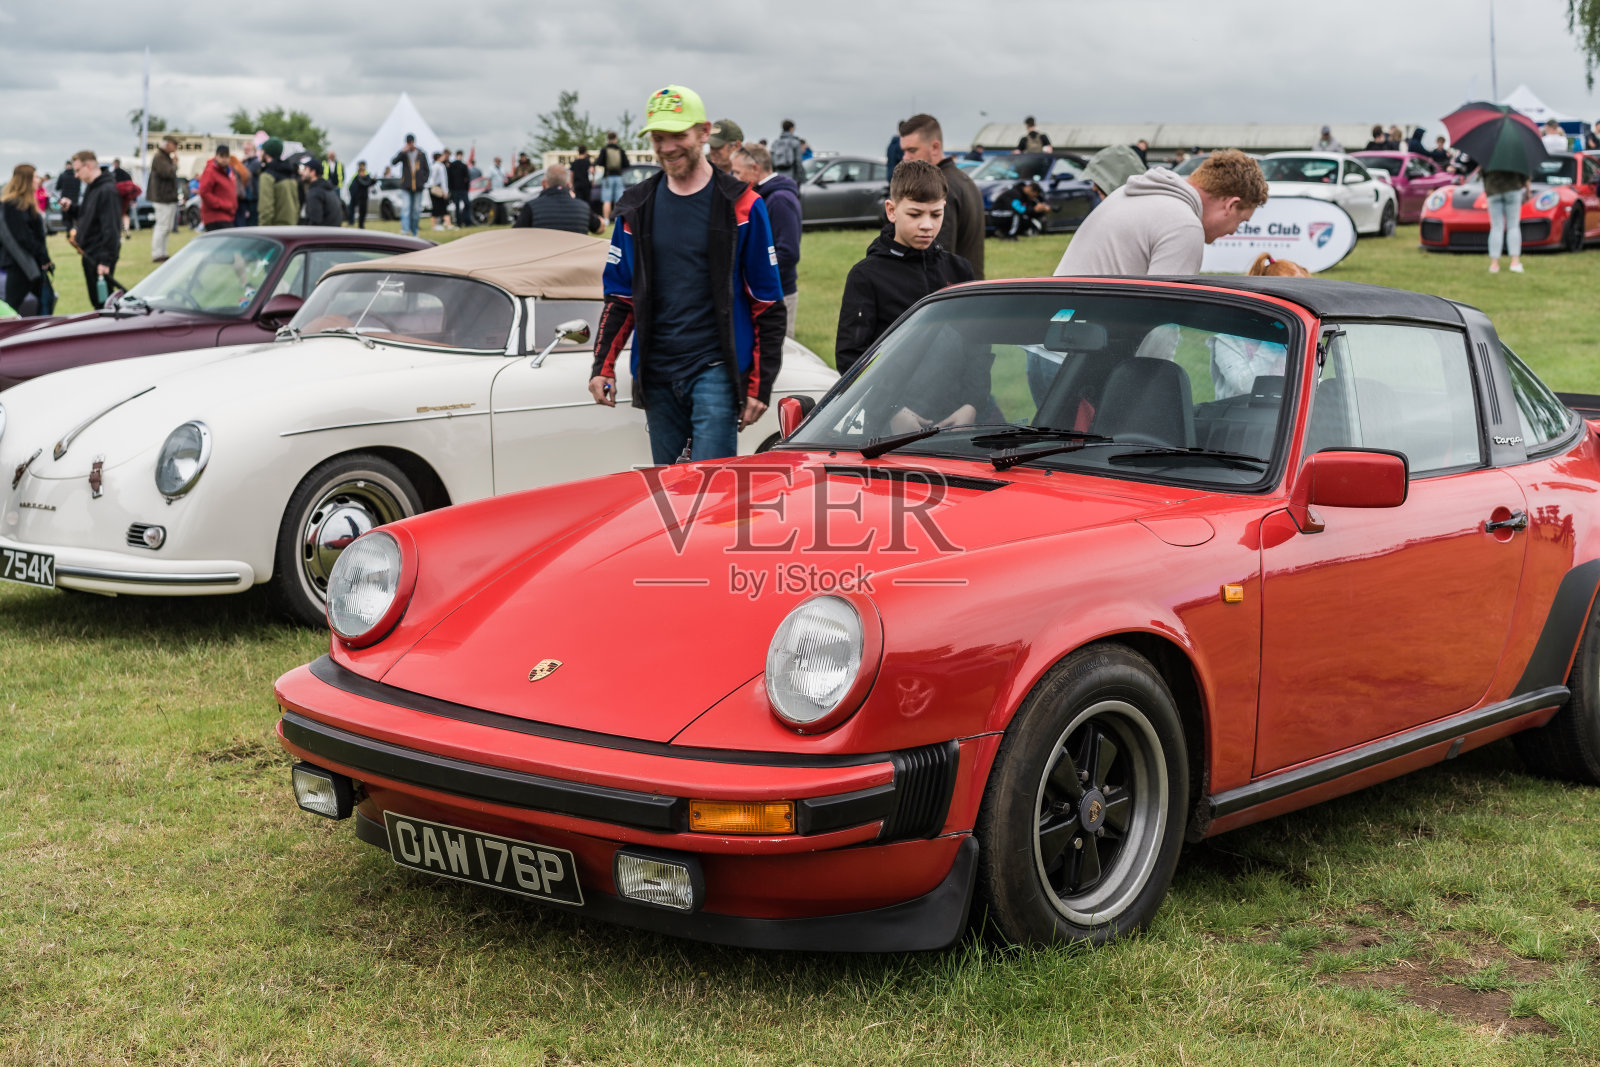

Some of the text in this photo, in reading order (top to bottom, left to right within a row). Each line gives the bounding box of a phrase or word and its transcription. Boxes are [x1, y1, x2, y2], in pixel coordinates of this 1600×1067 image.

[1267, 222, 1301, 235] Club
[3, 549, 53, 585] 754K
[396, 820, 565, 894] OAW 176P
